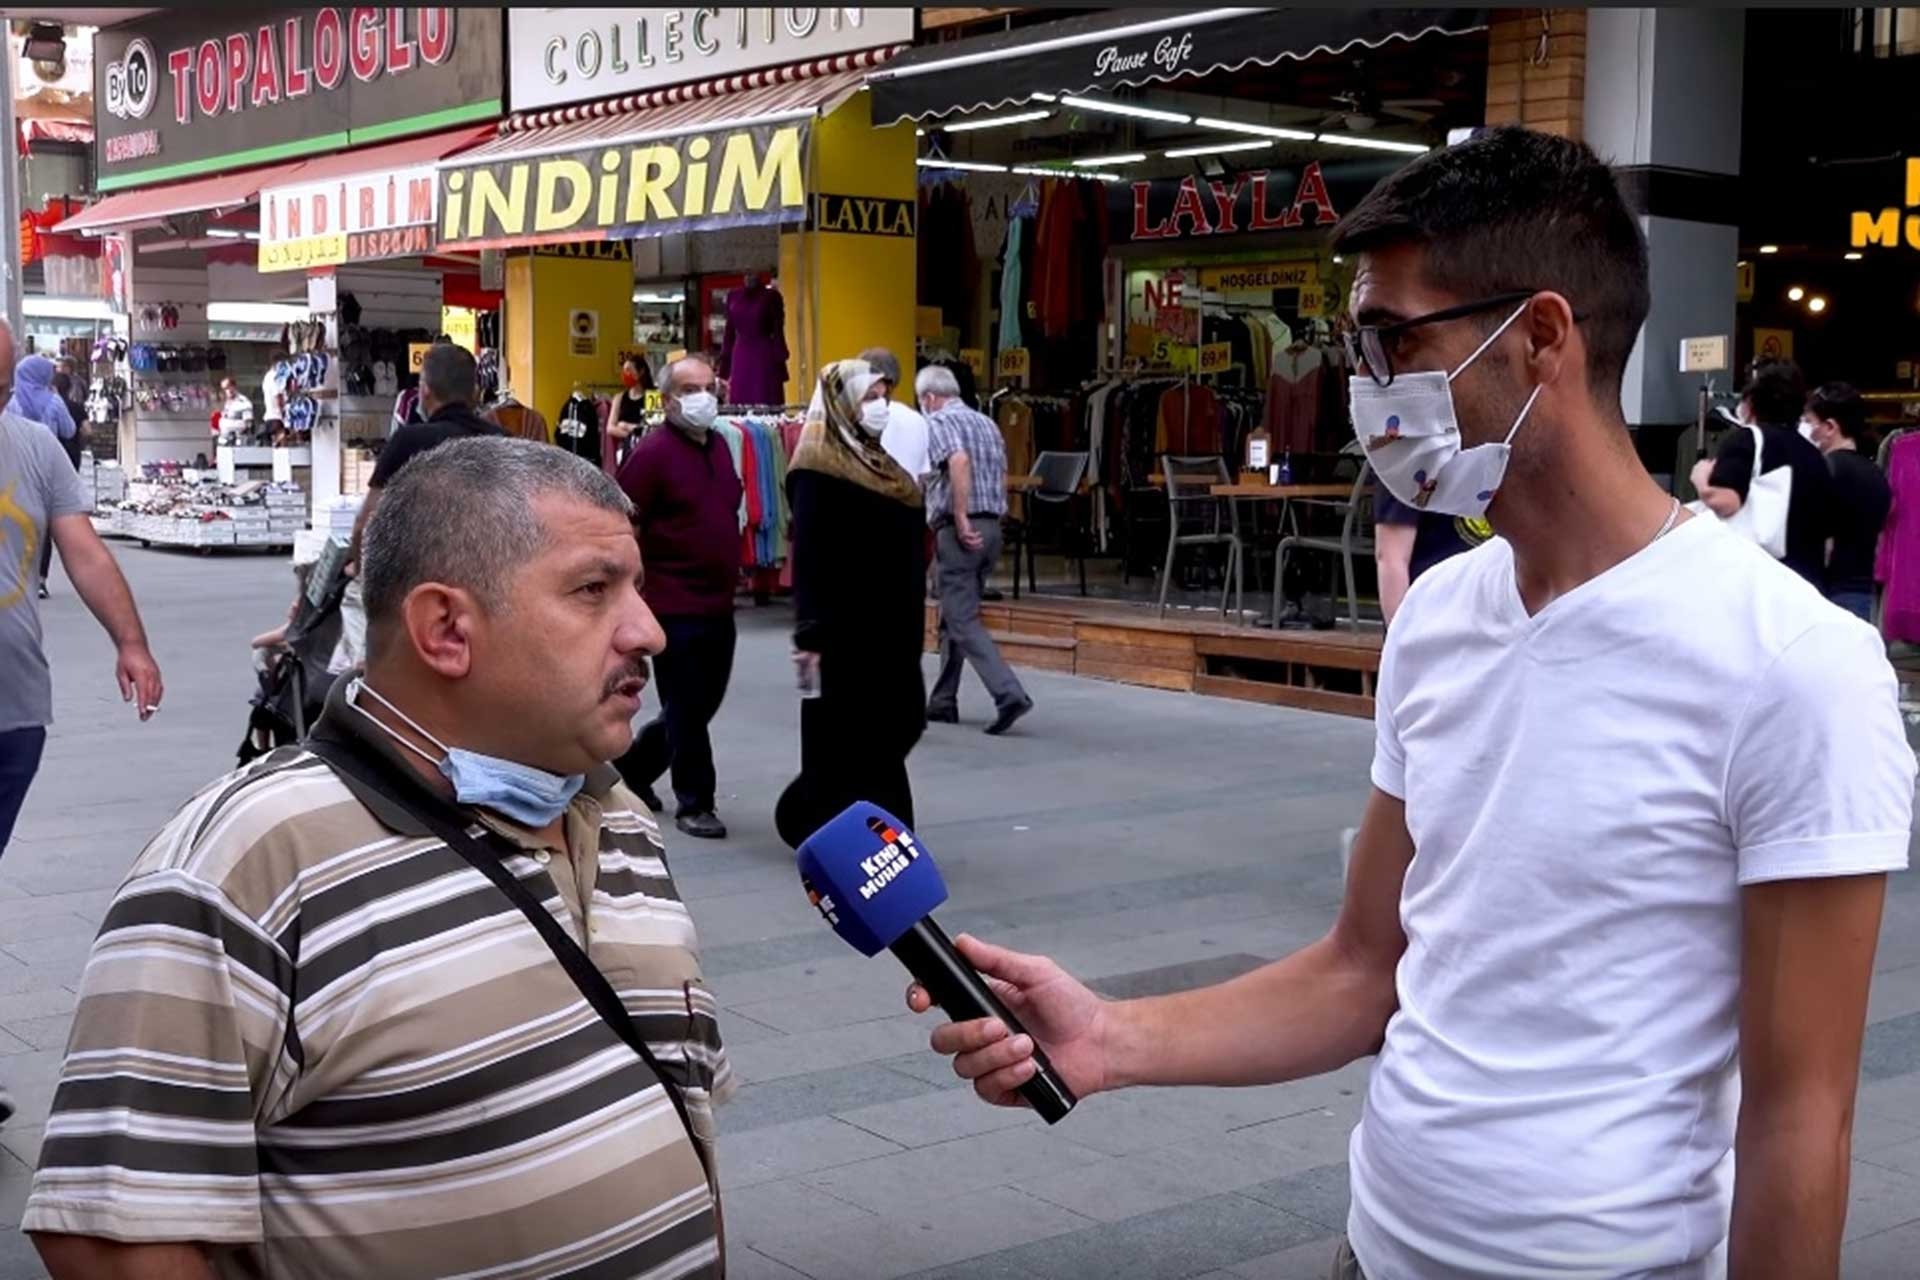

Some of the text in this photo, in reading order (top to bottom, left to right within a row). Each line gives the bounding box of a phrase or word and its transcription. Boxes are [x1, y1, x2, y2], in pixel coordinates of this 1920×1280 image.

[1093, 46, 1149, 77] Pause
[819, 196, 914, 235] LAYLA
[1130, 160, 1340, 241] LAYLA
